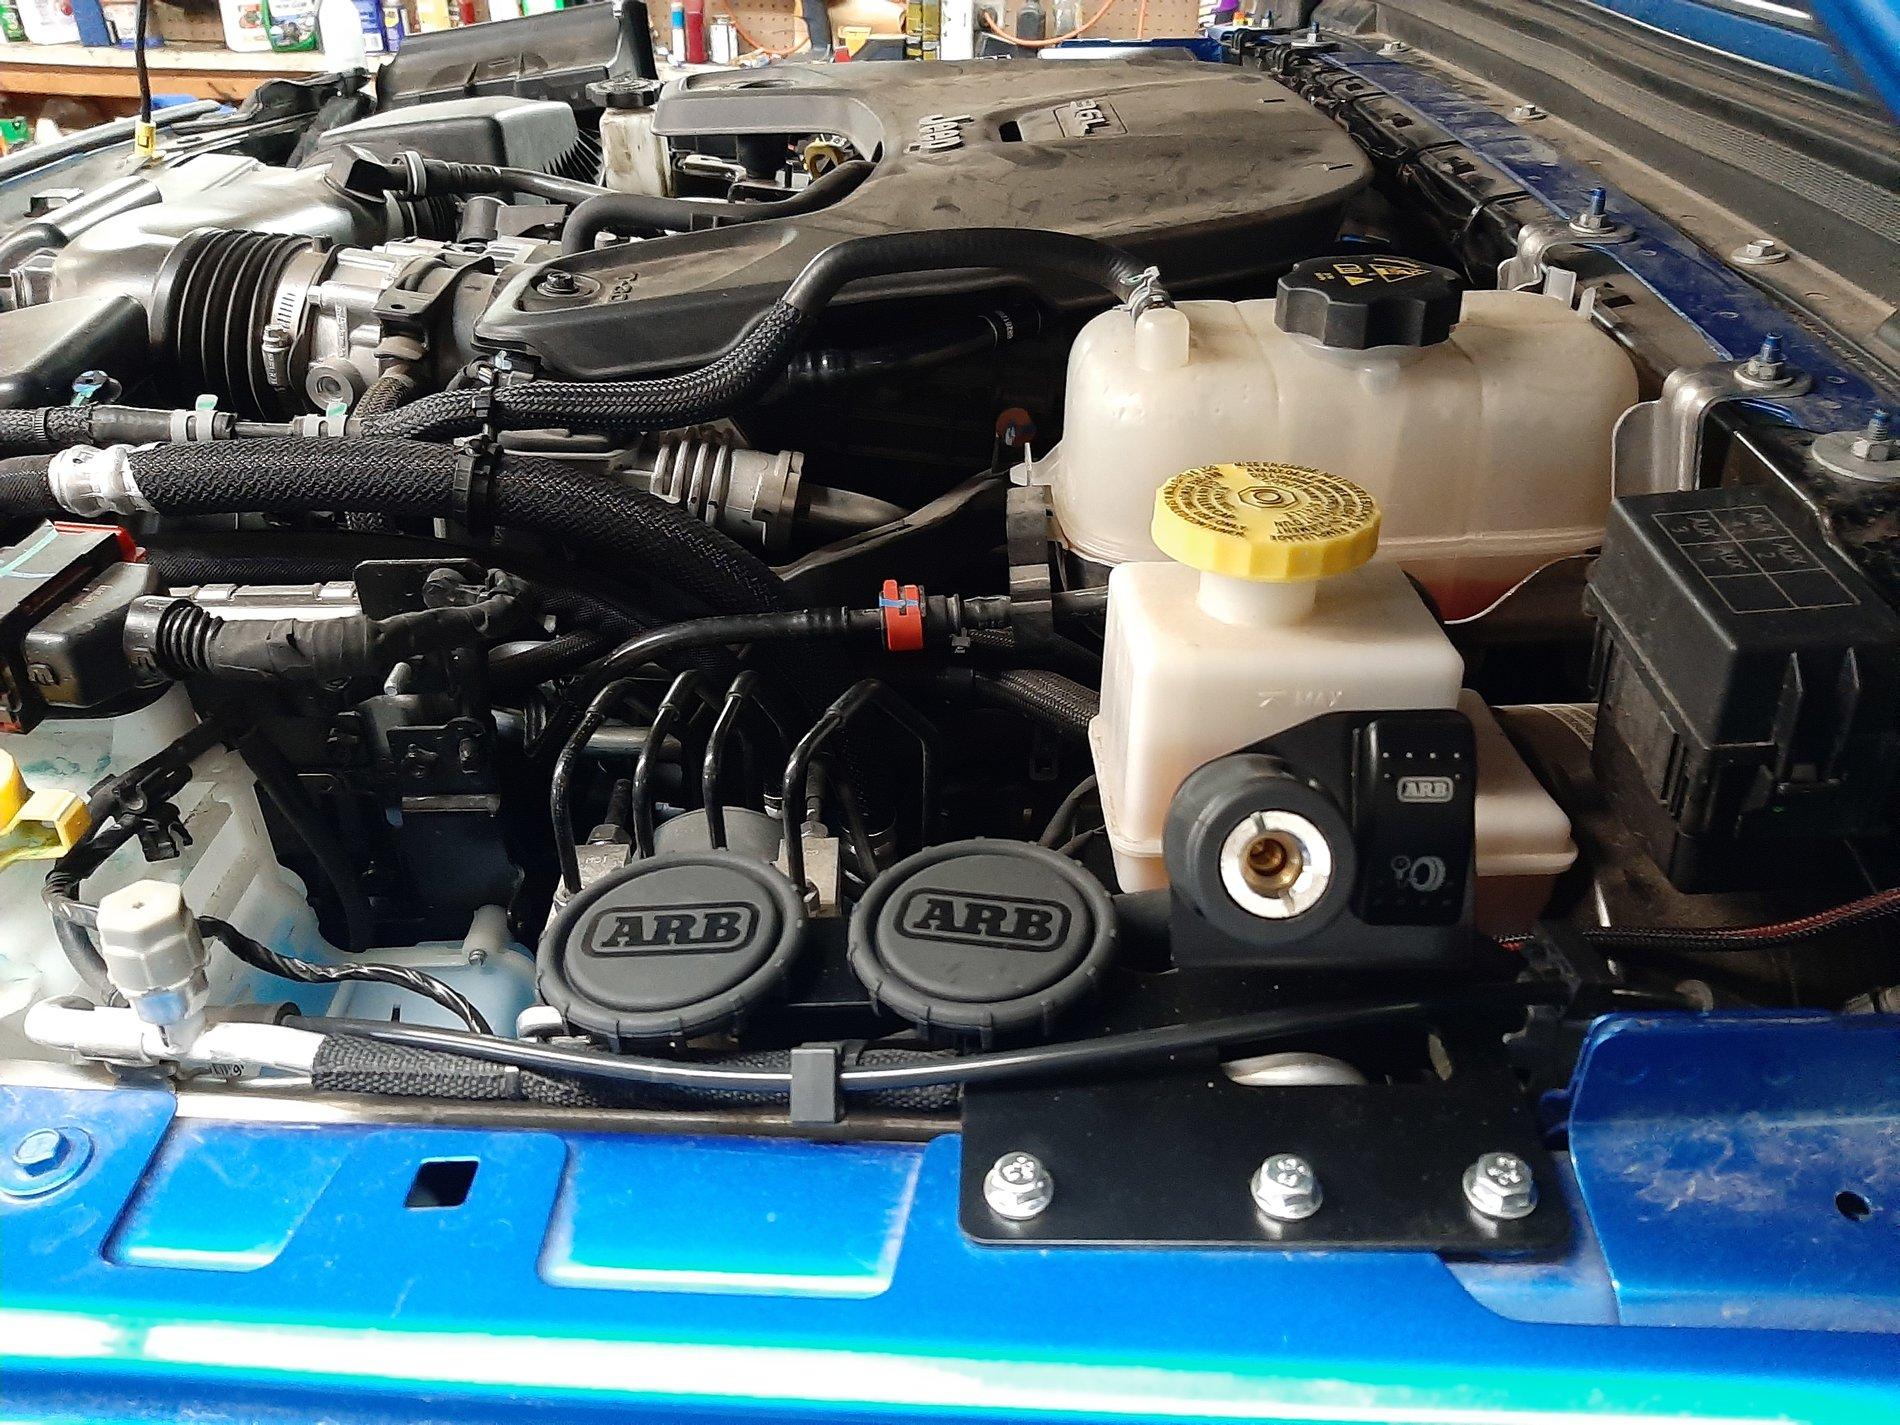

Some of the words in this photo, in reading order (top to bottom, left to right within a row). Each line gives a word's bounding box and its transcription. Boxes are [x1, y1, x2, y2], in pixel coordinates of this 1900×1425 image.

[1401, 780, 1450, 800] ARB
[599, 911, 745, 949] ARB
[912, 896, 1054, 942] ARB
